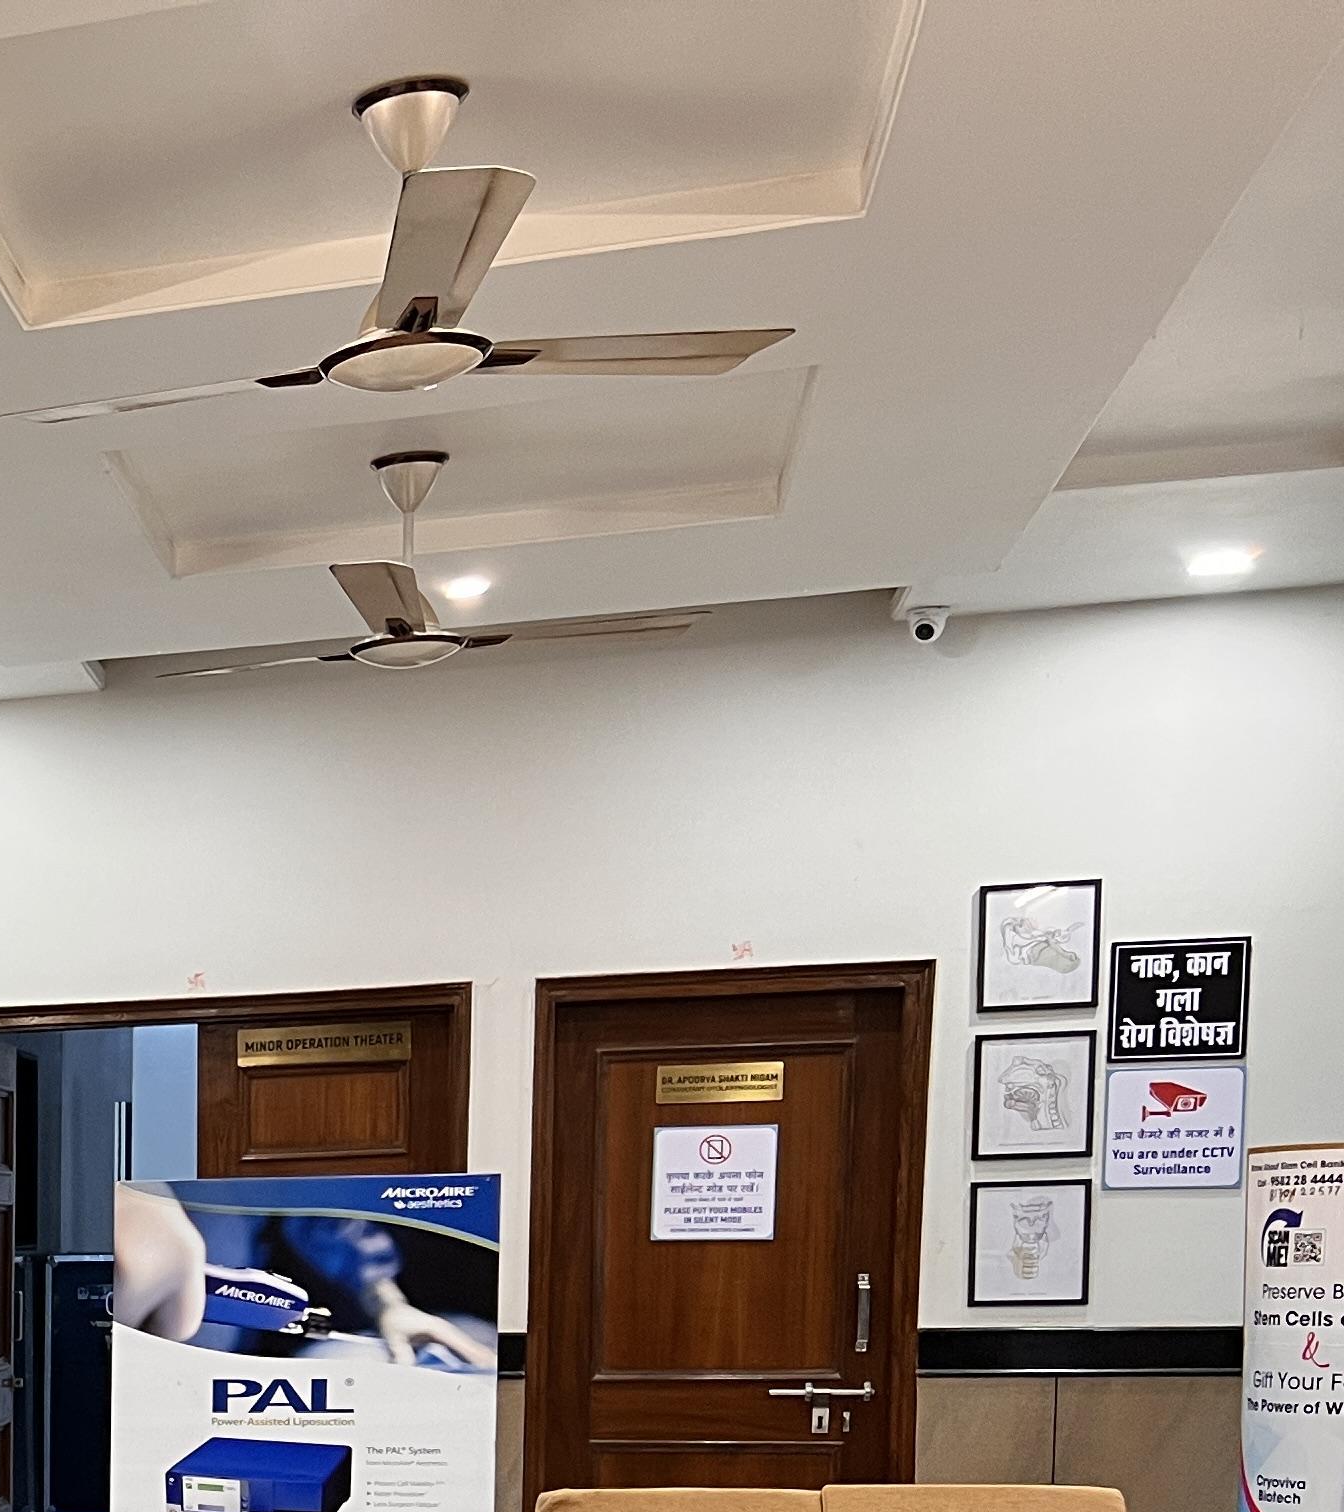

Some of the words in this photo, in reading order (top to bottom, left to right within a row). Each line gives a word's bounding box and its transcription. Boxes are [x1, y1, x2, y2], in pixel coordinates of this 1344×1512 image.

[1130, 954, 1180, 983] नाक,
[1185, 952, 1231, 976] कान
[1156, 987, 1202, 1012] गला
[1119, 1017, 1156, 1048] रोग
[1159, 1015, 1236, 1047] विशेषज्ञ
[244, 1040, 283, 1053] MINOR
[286, 1035, 350, 1051] OPERATION
[353, 1032, 403, 1046] THEATER
[1112, 1149, 1134, 1160] You
[1137, 1150, 1158, 1159] are
[1162, 1148, 1198, 1159] under
[1202, 1147, 1235, 1158] CCTV
[1300, 1161, 1317, 1169] Cell
[1294, 1175, 1307, 1185] 28
[1311, 1174, 1343, 1183] 4444
[381, 1186, 474, 1198] MICROAIRE
[214, 1284, 294, 1311] MICROAIRE
[1262, 1284, 1326, 1299] Preserve
[1254, 1311, 1281, 1326] Stem
[1286, 1311, 1333, 1327] Cells
[1253, 1370, 1273, 1389] Gift
[1278, 1371, 1324, 1391] Your
[1261, 1399, 1299, 1414] Power
[1303, 1401, 1321, 1414] of
[211, 1417, 290, 1427] Power-Assisted
[408, 1446, 441, 1455] System
[1257, 1474, 1306, 1490] Cryoviva
[1258, 1490, 1301, 1504] Biotech
